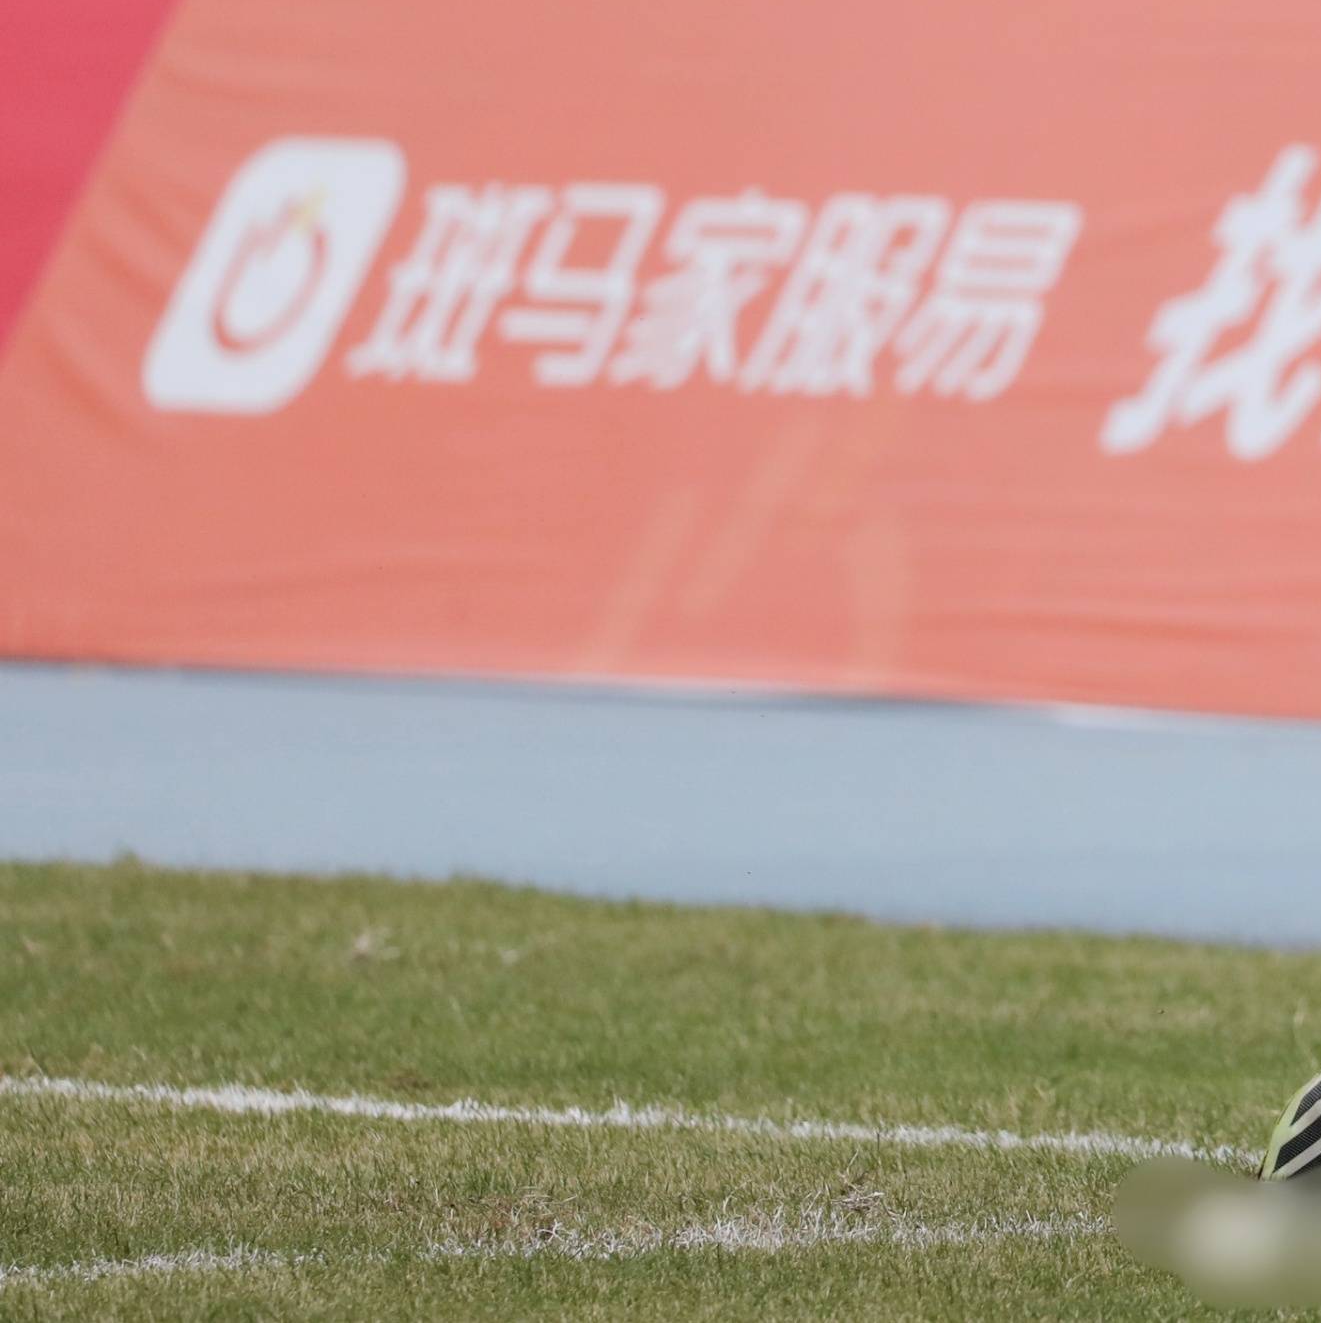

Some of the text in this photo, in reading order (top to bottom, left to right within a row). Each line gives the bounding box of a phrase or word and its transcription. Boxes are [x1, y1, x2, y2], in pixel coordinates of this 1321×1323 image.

[346, 184, 1083, 400] 斑马家服易
